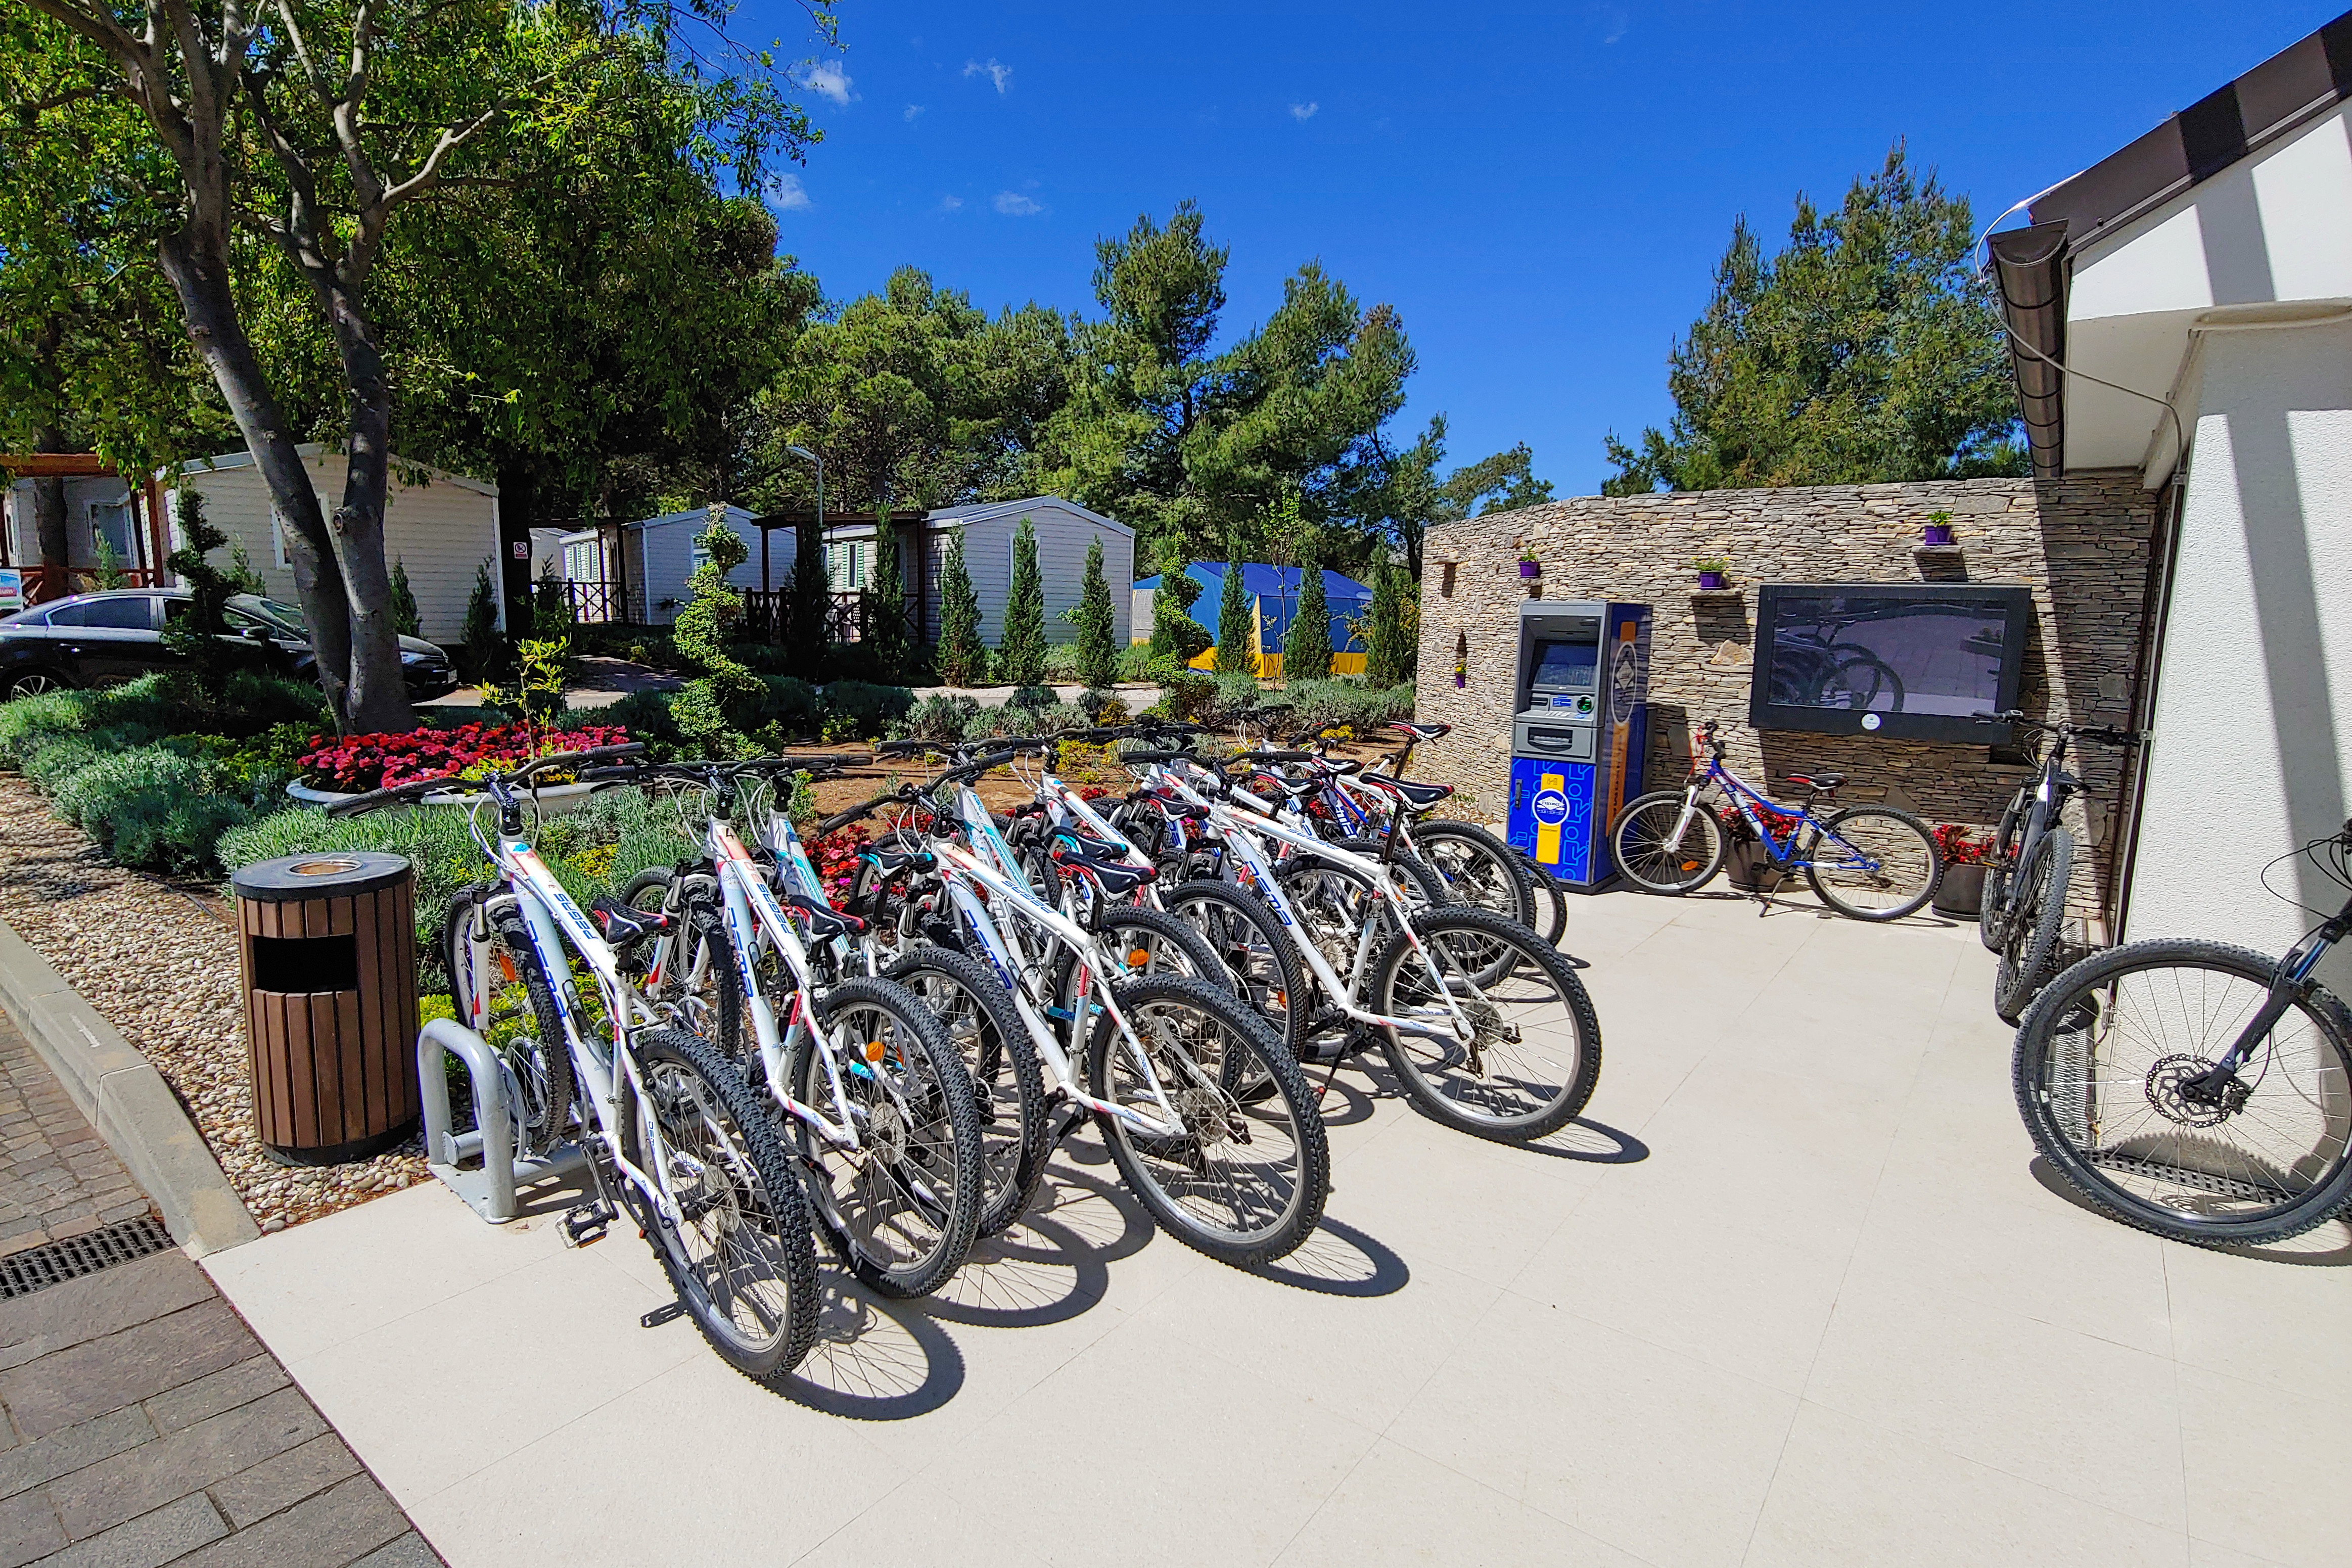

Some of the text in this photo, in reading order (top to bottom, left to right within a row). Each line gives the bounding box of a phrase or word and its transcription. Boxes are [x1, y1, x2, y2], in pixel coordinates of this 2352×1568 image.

[726, 828, 735, 840] 4
[554, 893, 599, 939] PEGAS
[756, 883, 794, 935] PEGAS
[1001, 881, 1055, 914] PEGAS
[2028, 1080, 2077, 1167] SCHWALBE
